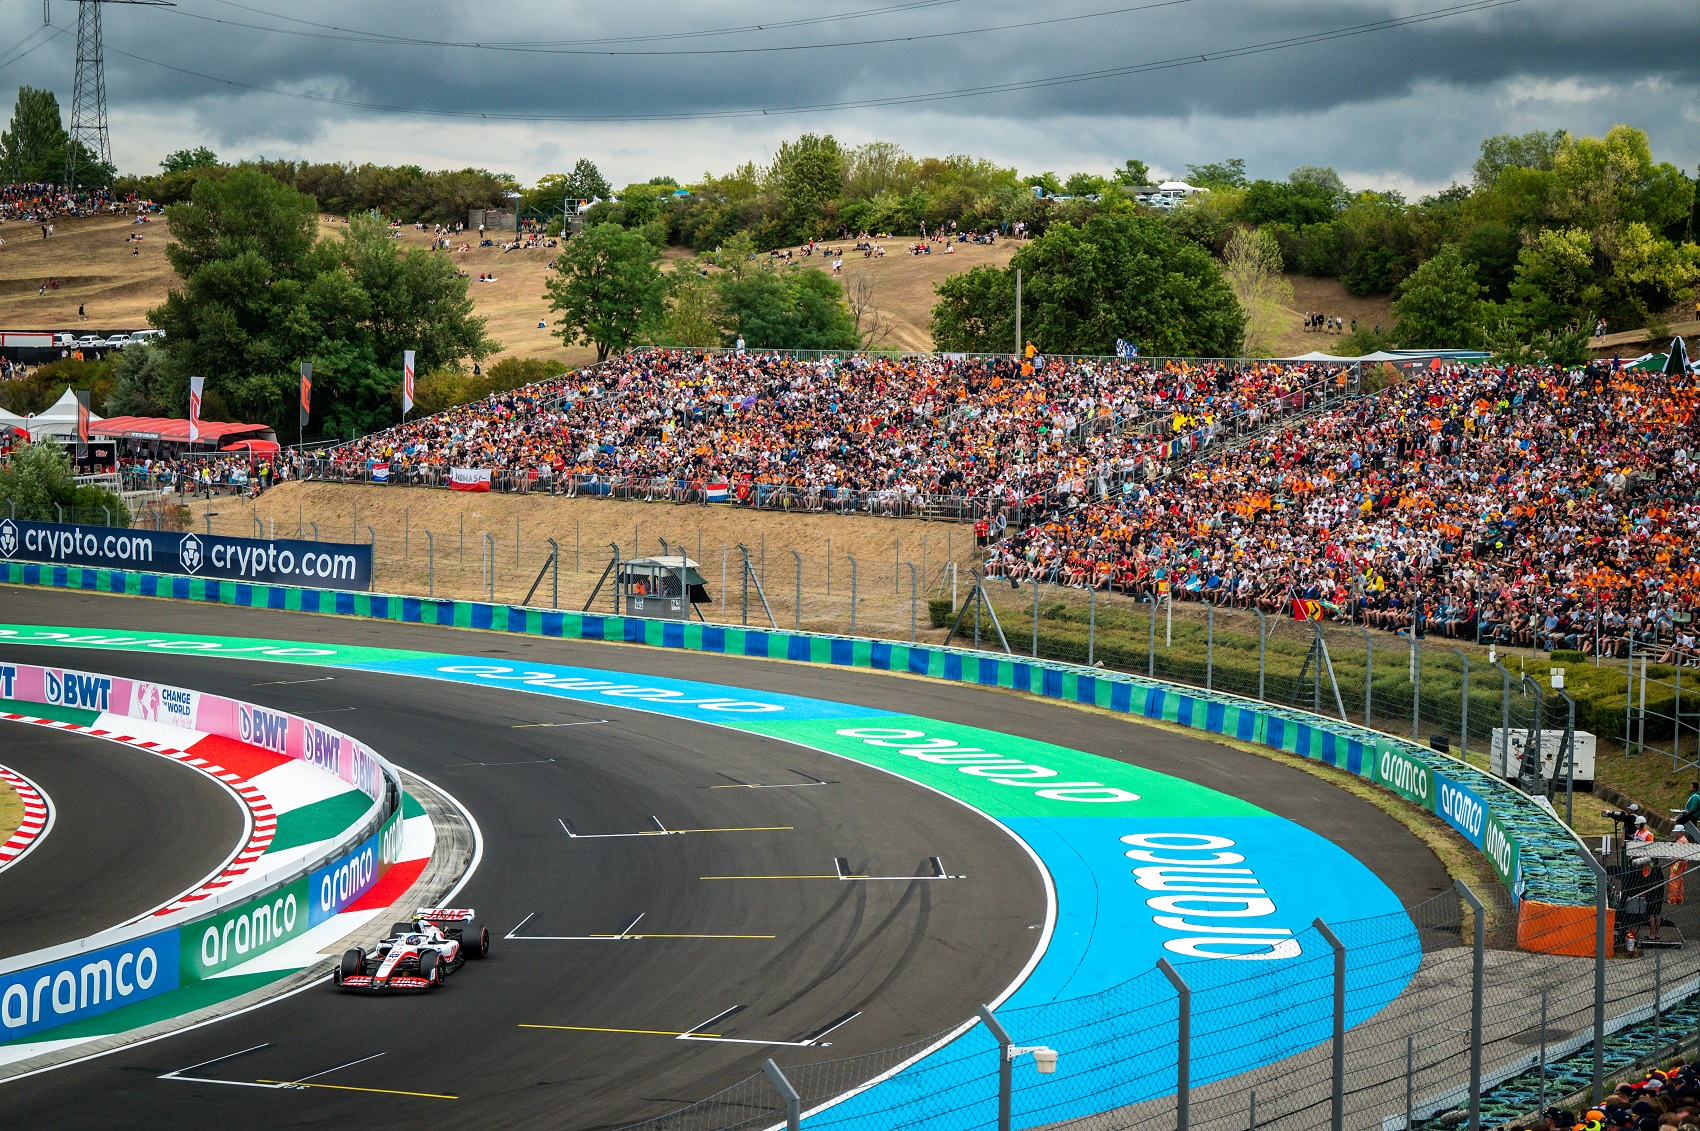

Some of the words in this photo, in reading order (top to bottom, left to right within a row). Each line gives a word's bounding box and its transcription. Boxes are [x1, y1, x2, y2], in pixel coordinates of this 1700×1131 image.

[25, 528, 153, 561] crypto.com
[211, 544, 356, 580] crypto.com
[64, 673, 110, 710] BWT
[162, 688, 191, 705] CHANGE
[168, 702, 190, 716] WORLD
[436, 665, 786, 713] aramco
[253, 709, 288, 752] BWT
[314, 727, 341, 774] BWT
[360, 749, 376, 796] BWT
[834, 727, 1143, 803] aramco
[1380, 749, 1428, 800] aramco
[1441, 783, 1482, 838] aramco
[320, 845, 373, 912] aramco
[1119, 833, 1303, 961] aramco
[201, 892, 296, 967] aramco
[421, 908, 469, 921] HAAS
[1, 947, 158, 1029] aramco
